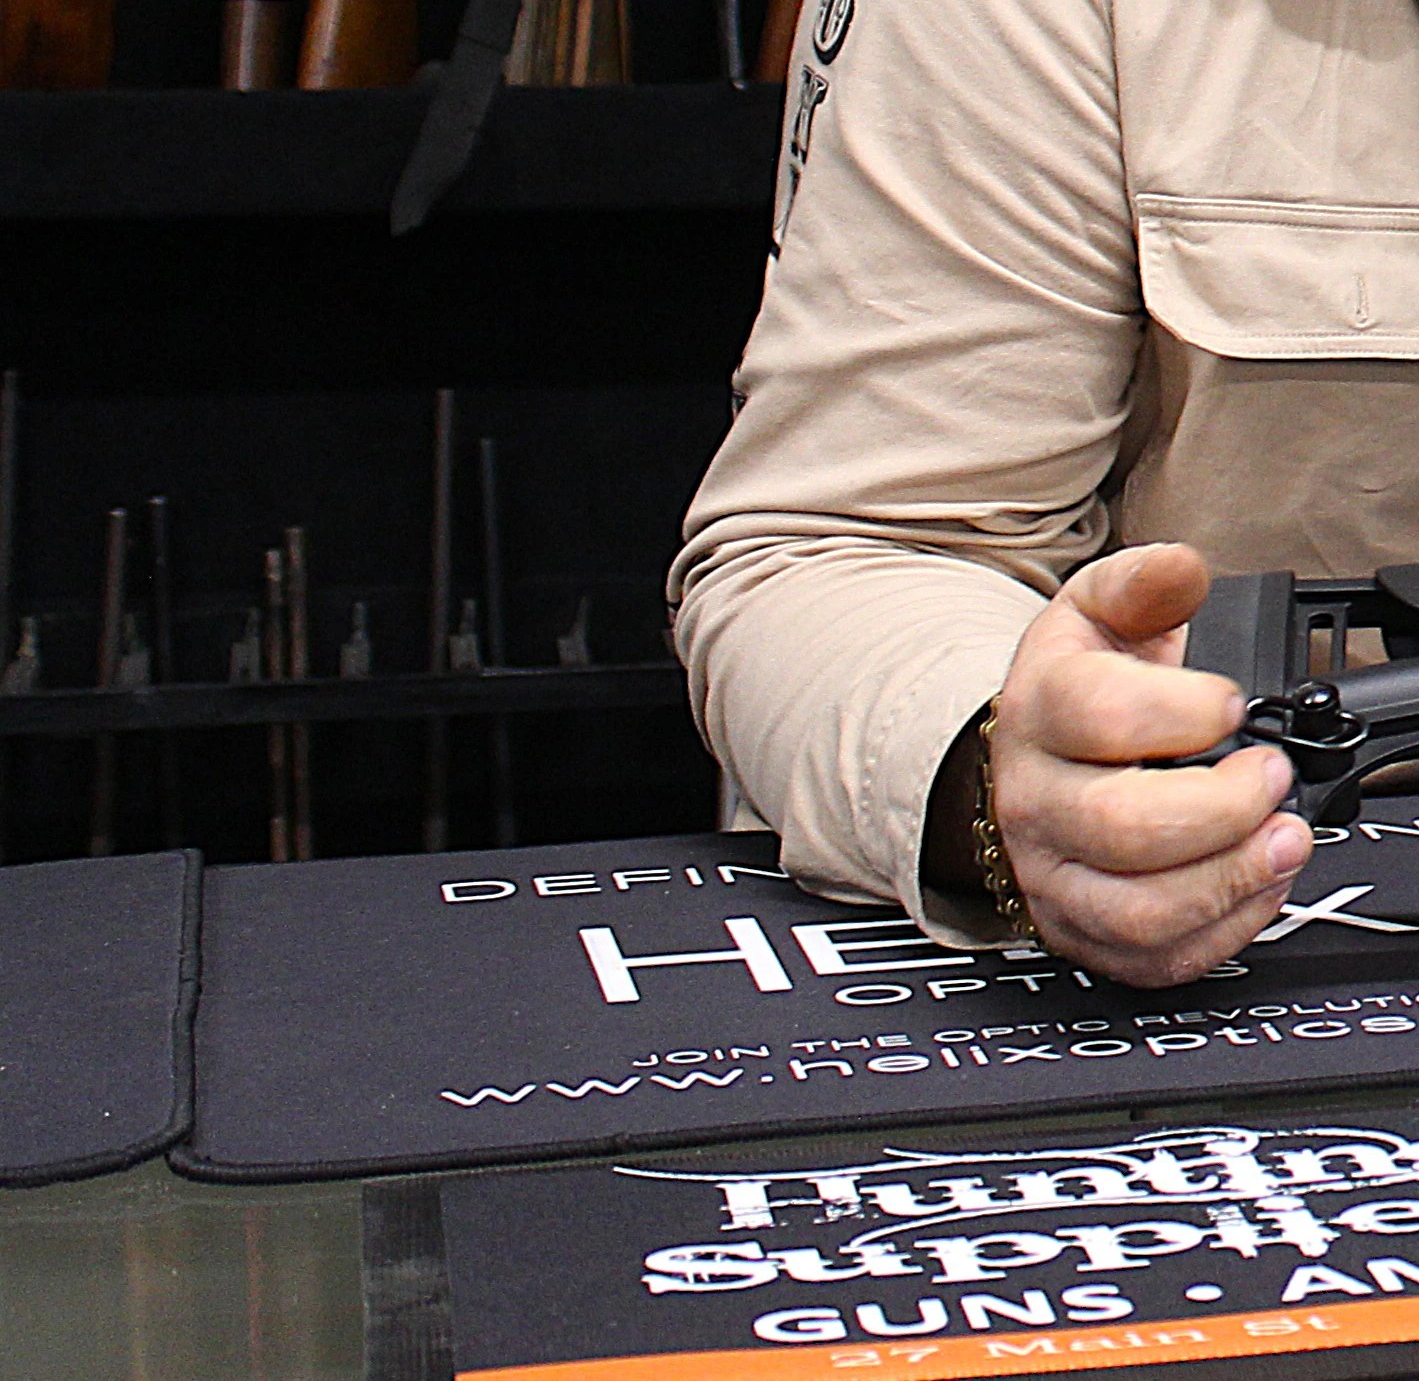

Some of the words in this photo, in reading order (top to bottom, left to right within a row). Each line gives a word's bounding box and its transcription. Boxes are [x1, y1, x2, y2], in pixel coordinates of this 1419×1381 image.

[834, 959, 1251, 1006] OPTIS
[632, 1044, 770, 1069] JOIN
[791, 1033, 914, 1055] THE
[933, 1020, 1111, 1045] OPTIC
[753, 1283, 1135, 1343] GUNS
[830, 1346, 940, 1369] 27
[984, 1327, 1213, 1360] Main
[1242, 1312, 1342, 1337] St
